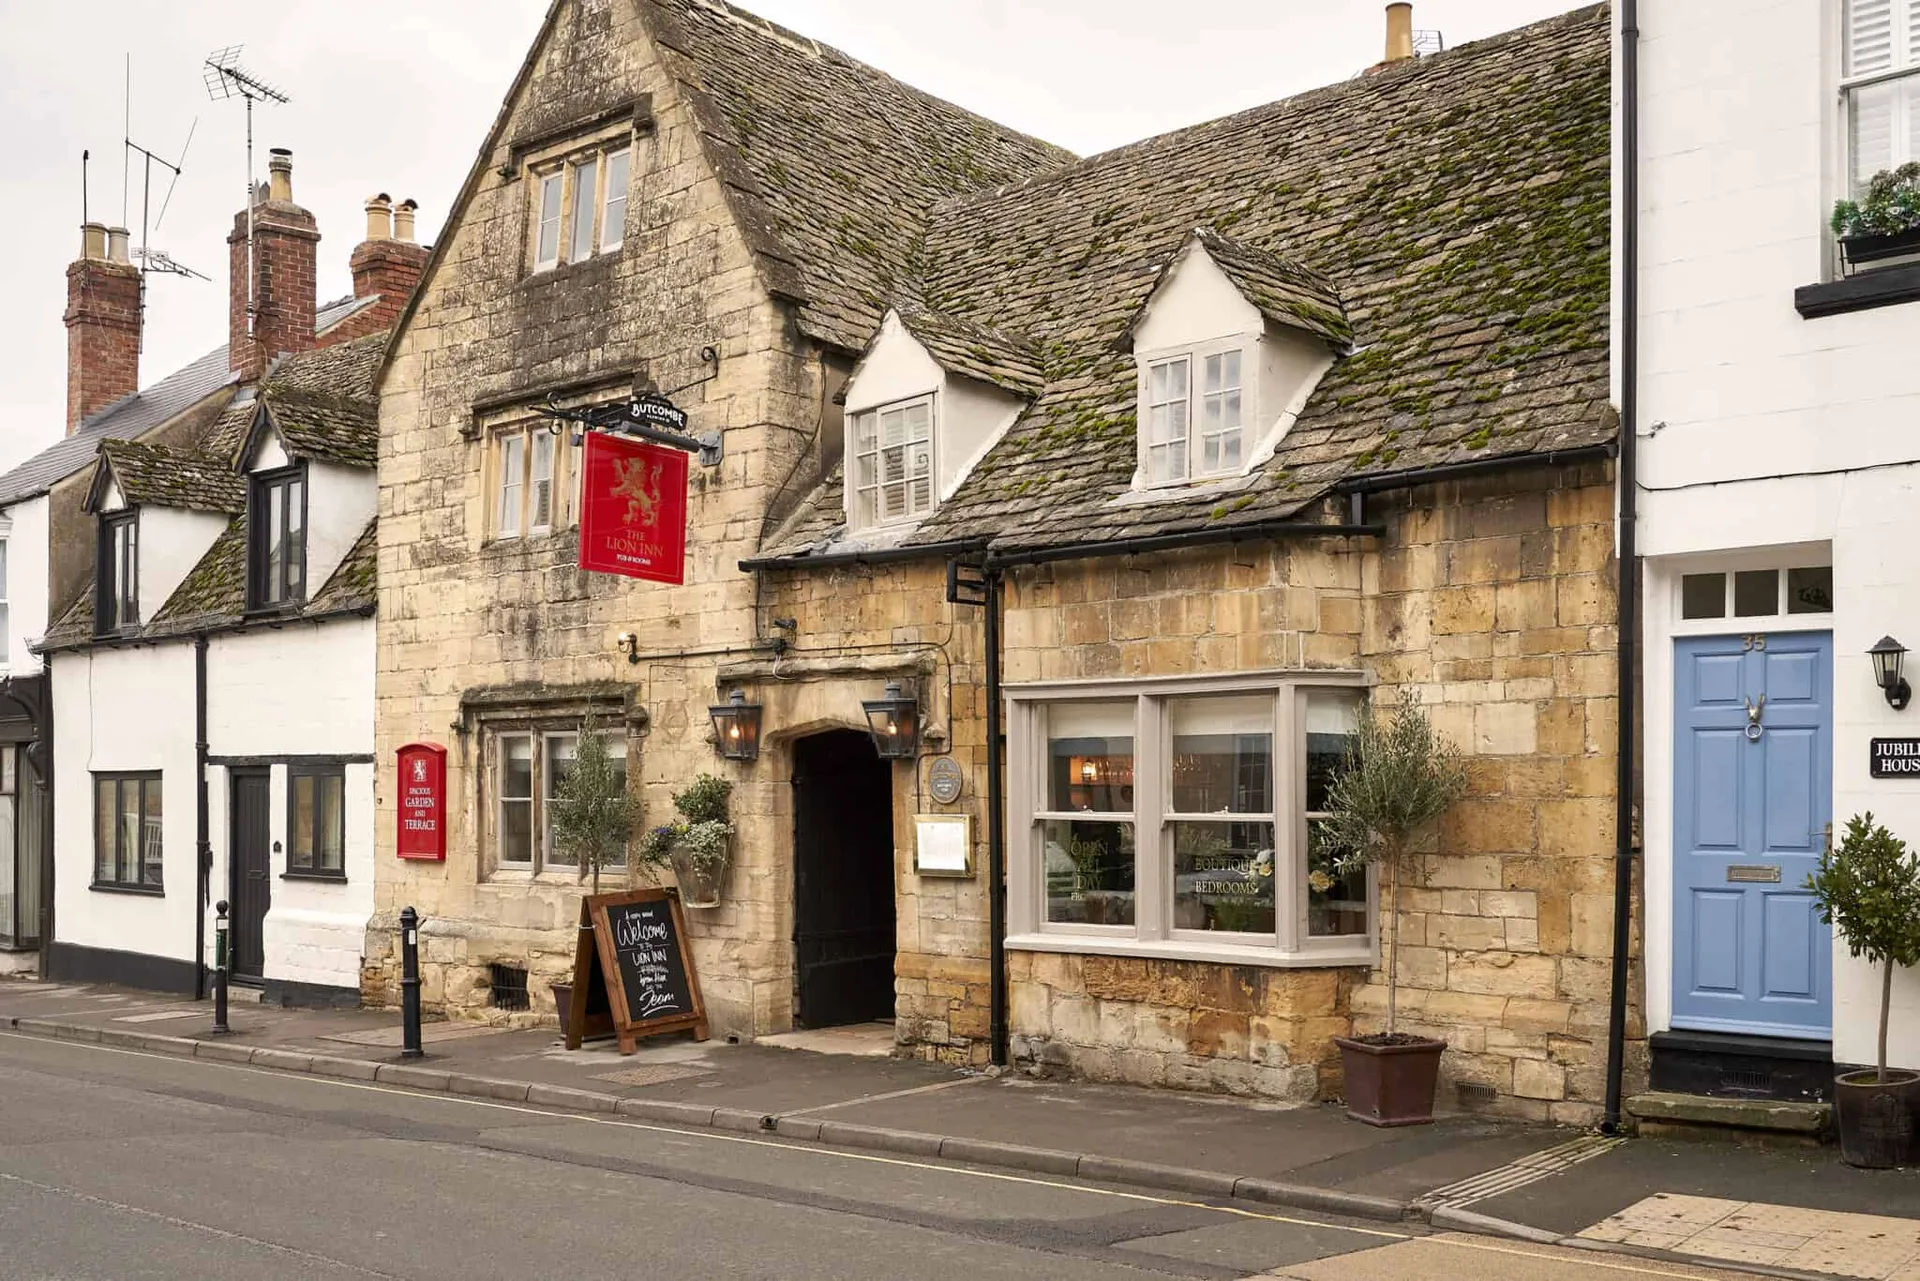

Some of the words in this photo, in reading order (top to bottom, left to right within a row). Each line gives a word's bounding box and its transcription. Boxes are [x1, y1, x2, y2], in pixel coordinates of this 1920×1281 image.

[631, 403, 684, 427] BUTCOMBE
[626, 530, 646, 541] THE
[606, 536, 637, 553] LION
[639, 541, 664, 558] INN
[1741, 634, 1765, 651] 35
[1195, 881, 1256, 894] BEDROOMS
[617, 919, 668, 946] Welcome
